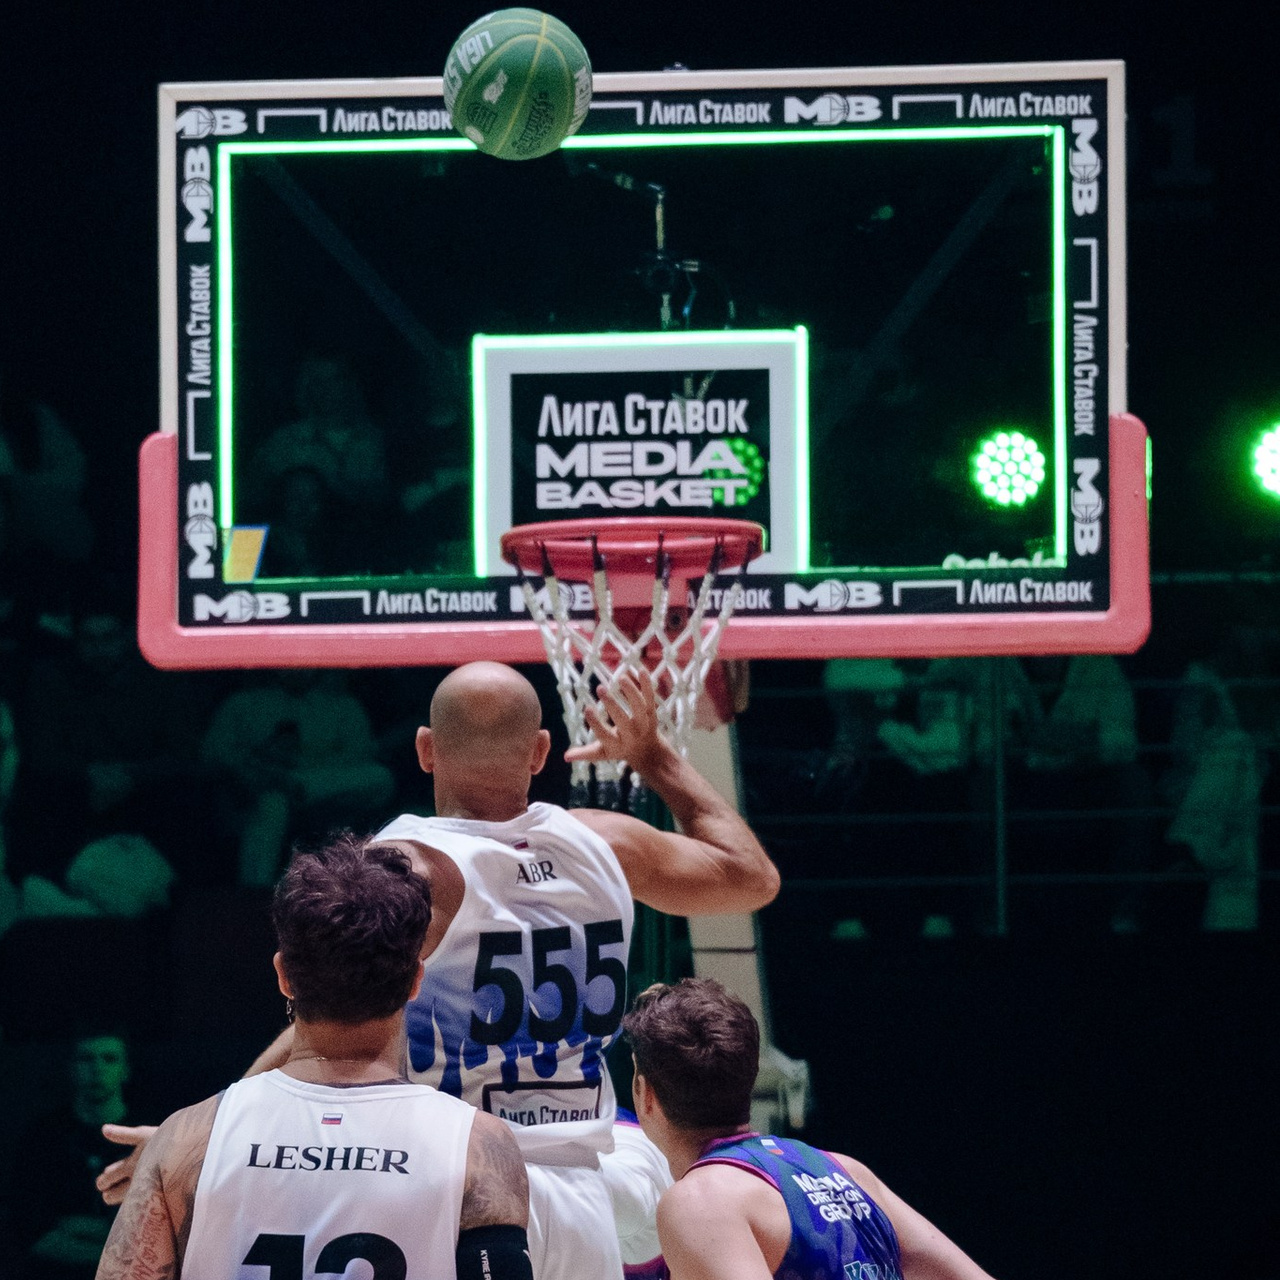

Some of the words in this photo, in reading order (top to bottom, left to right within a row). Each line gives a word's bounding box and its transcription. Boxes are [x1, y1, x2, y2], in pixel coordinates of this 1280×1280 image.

[535, 439, 747, 478] MEDIA
[535, 477, 748, 510] BASKET
[516, 860, 558, 884] ABR
[470, 919, 627, 1045] 555
[247, 1144, 408, 1174] LESHER
